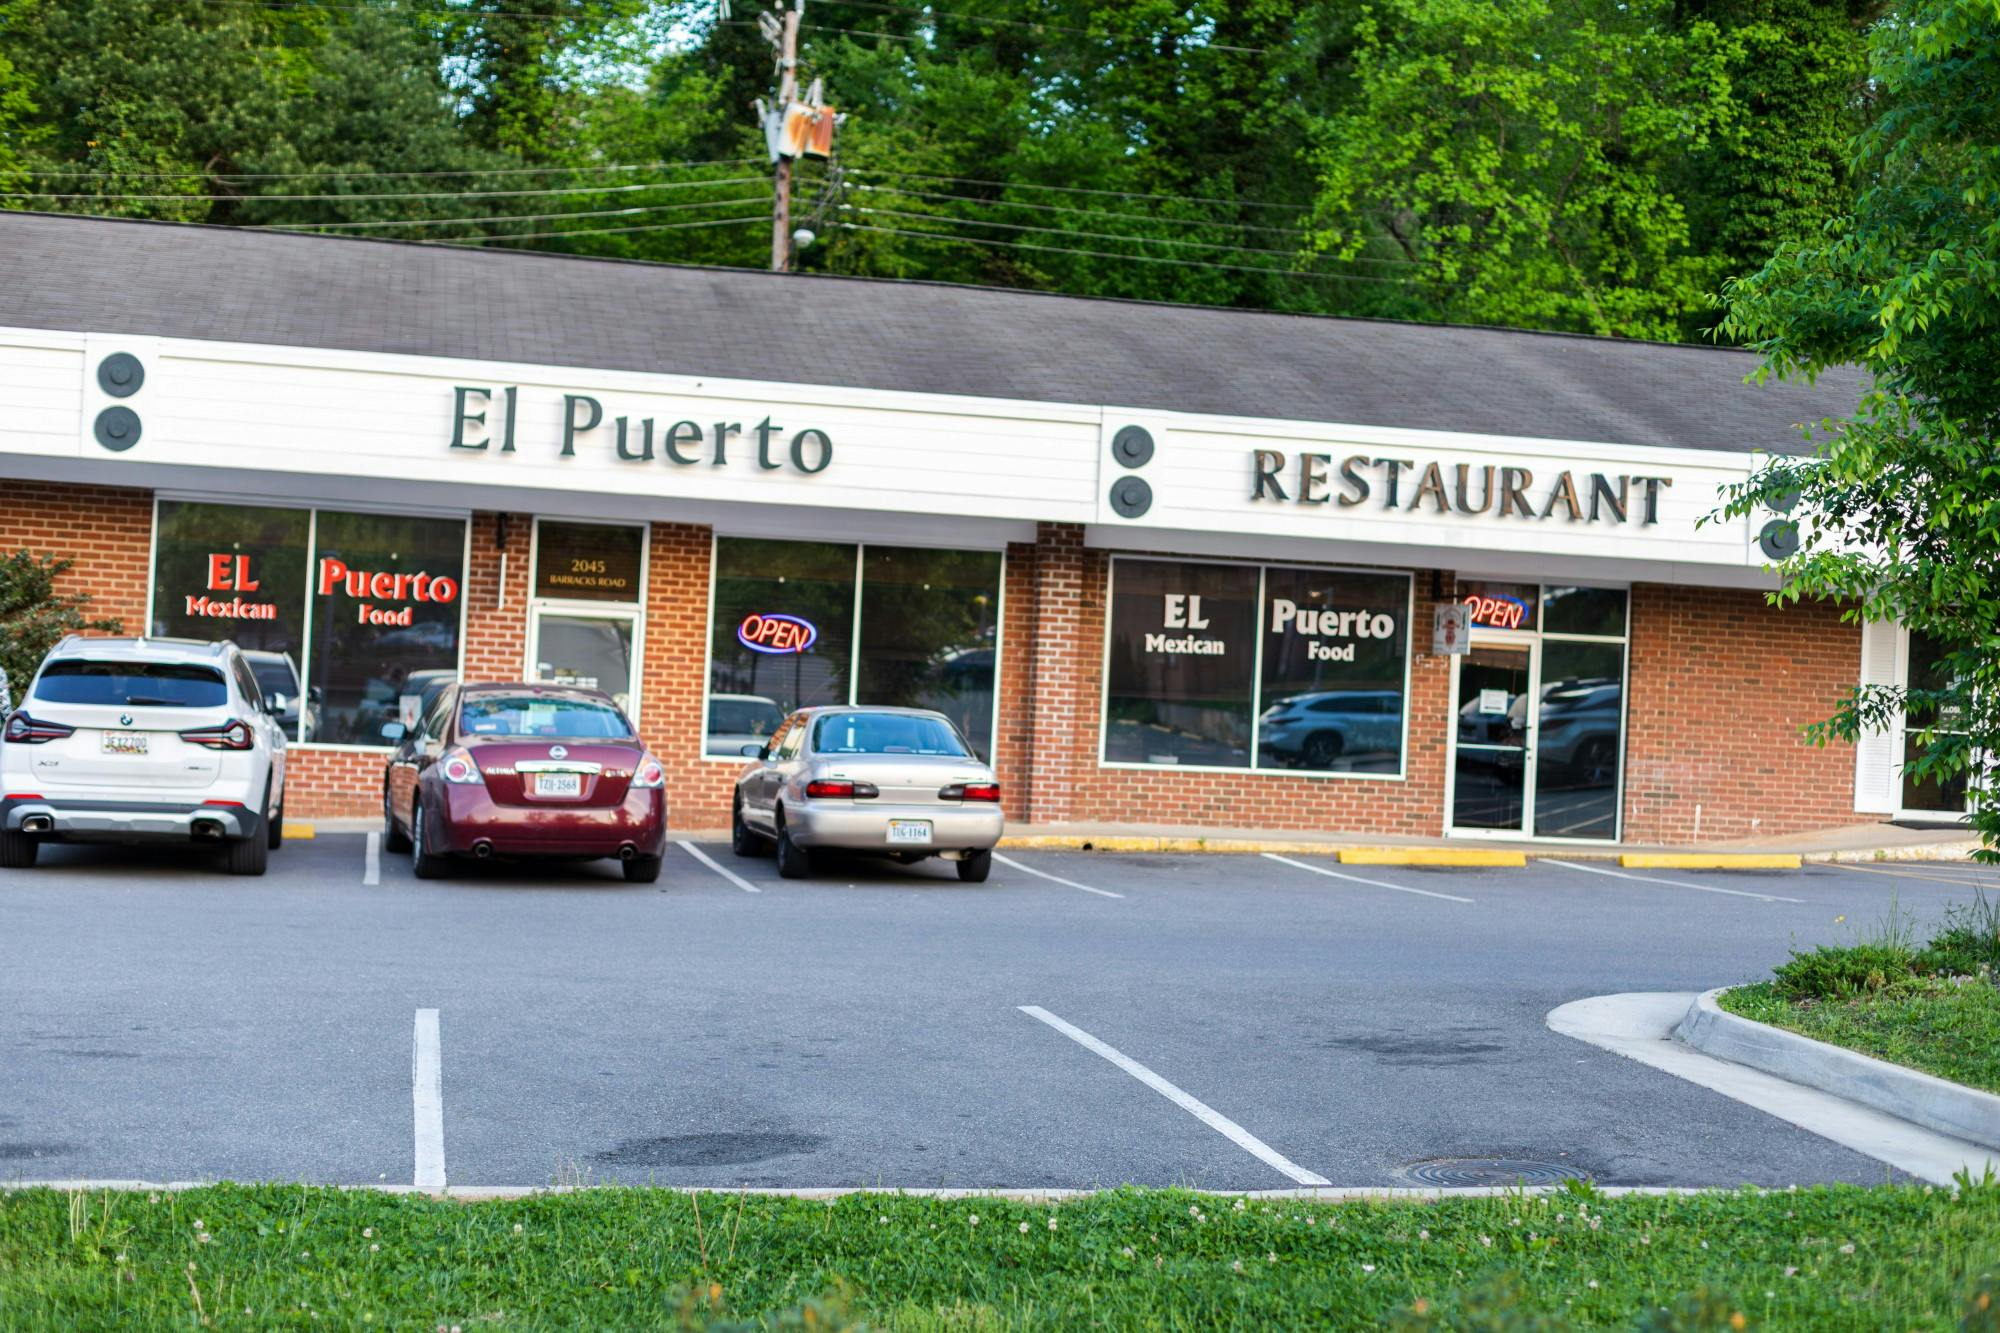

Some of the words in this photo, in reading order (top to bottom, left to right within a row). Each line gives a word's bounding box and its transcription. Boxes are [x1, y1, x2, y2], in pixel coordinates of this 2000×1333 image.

[449, 385, 518, 451] El
[559, 393, 833, 474] Puerto
[1251, 448, 1673, 525] RESTAURANT
[207, 553, 260, 592] EL
[318, 558, 458, 604] Puerto
[549, 574, 596, 587] BARRACKS
[598, 577, 626, 588] ROAD
[570, 559, 606, 574] 2045
[185, 594, 277, 620] Mexican
[358, 604, 413, 626] Food
[1164, 594, 1209, 629] EL
[1272, 599, 1395, 639] Puerto
[1464, 595, 1523, 629] OPEN
[741, 615, 809, 652] OPEN
[1145, 633, 1225, 655] Mexican
[1308, 641, 1355, 662] Food
